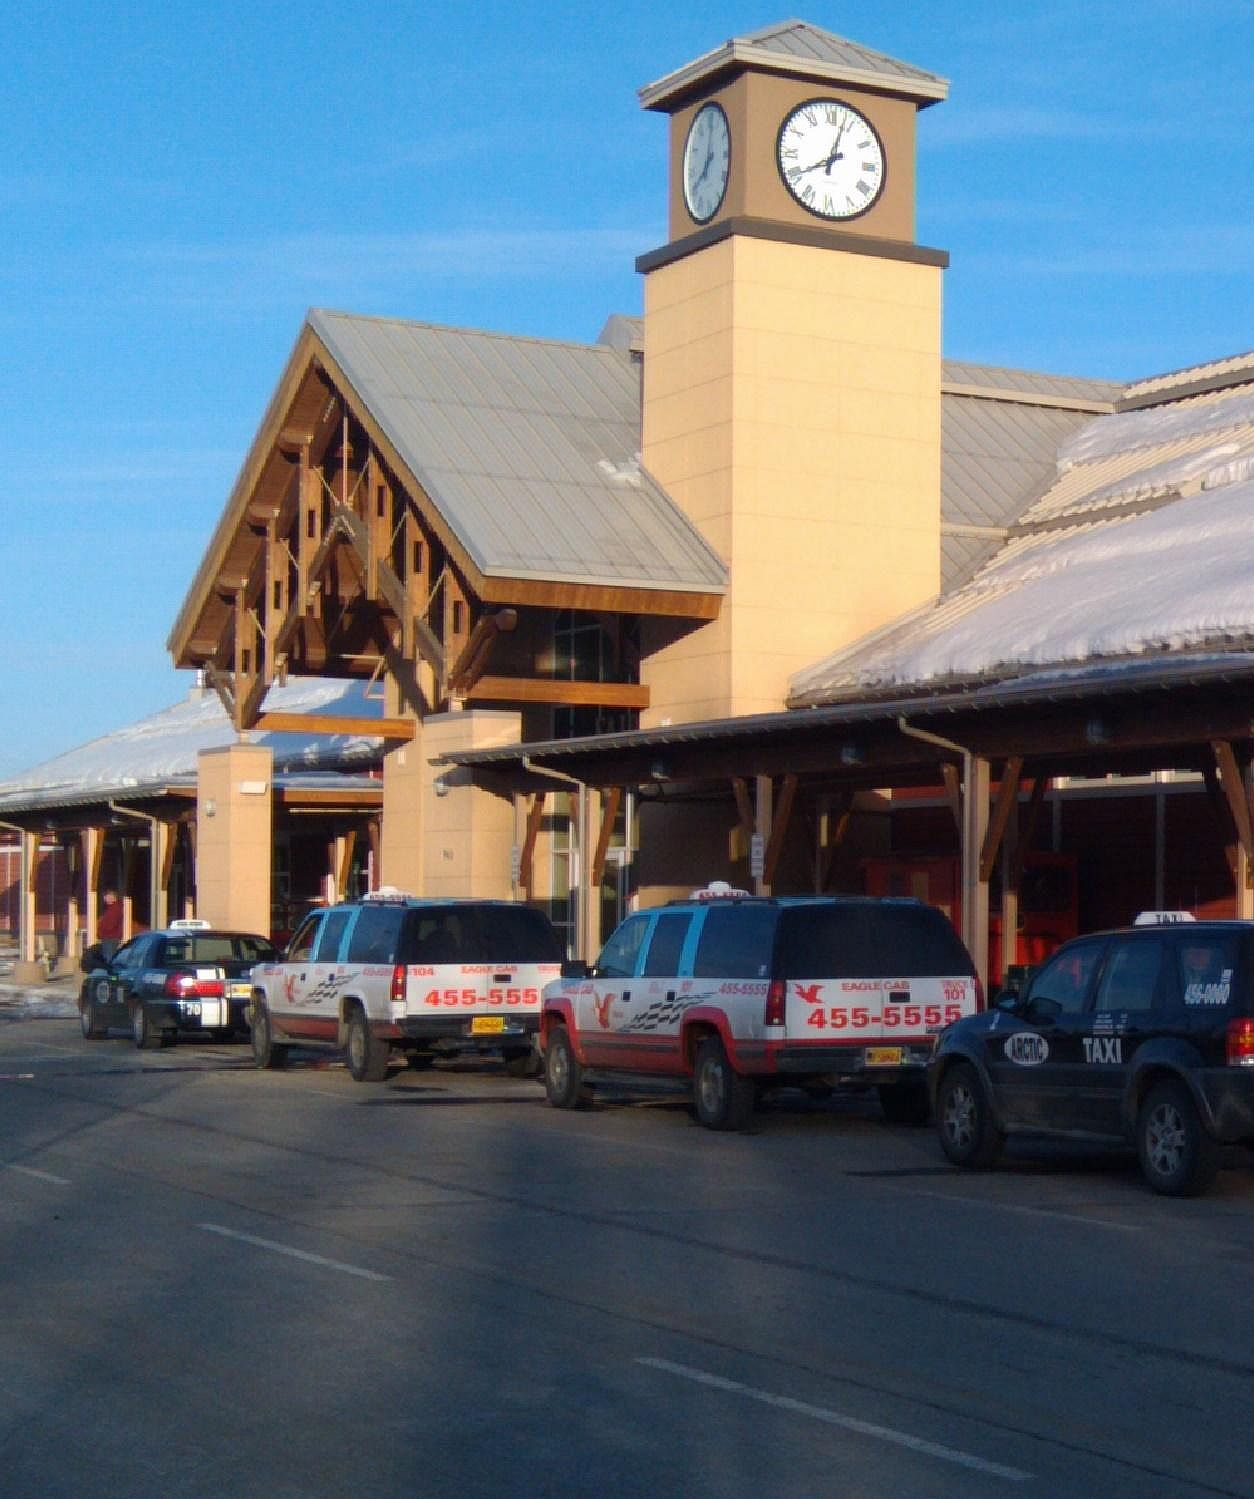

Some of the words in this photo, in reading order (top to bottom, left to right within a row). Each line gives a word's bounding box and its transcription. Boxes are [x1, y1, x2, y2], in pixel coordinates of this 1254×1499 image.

[842, 981, 880, 991] EAGLE
[883, 980, 911, 990] CAB
[944, 989, 966, 1000] 101
[807, 1004, 962, 1030] 455-5555
[1009, 1038, 1043, 1060] ARCTIC
[1082, 1038, 1122, 1064] TAXI
